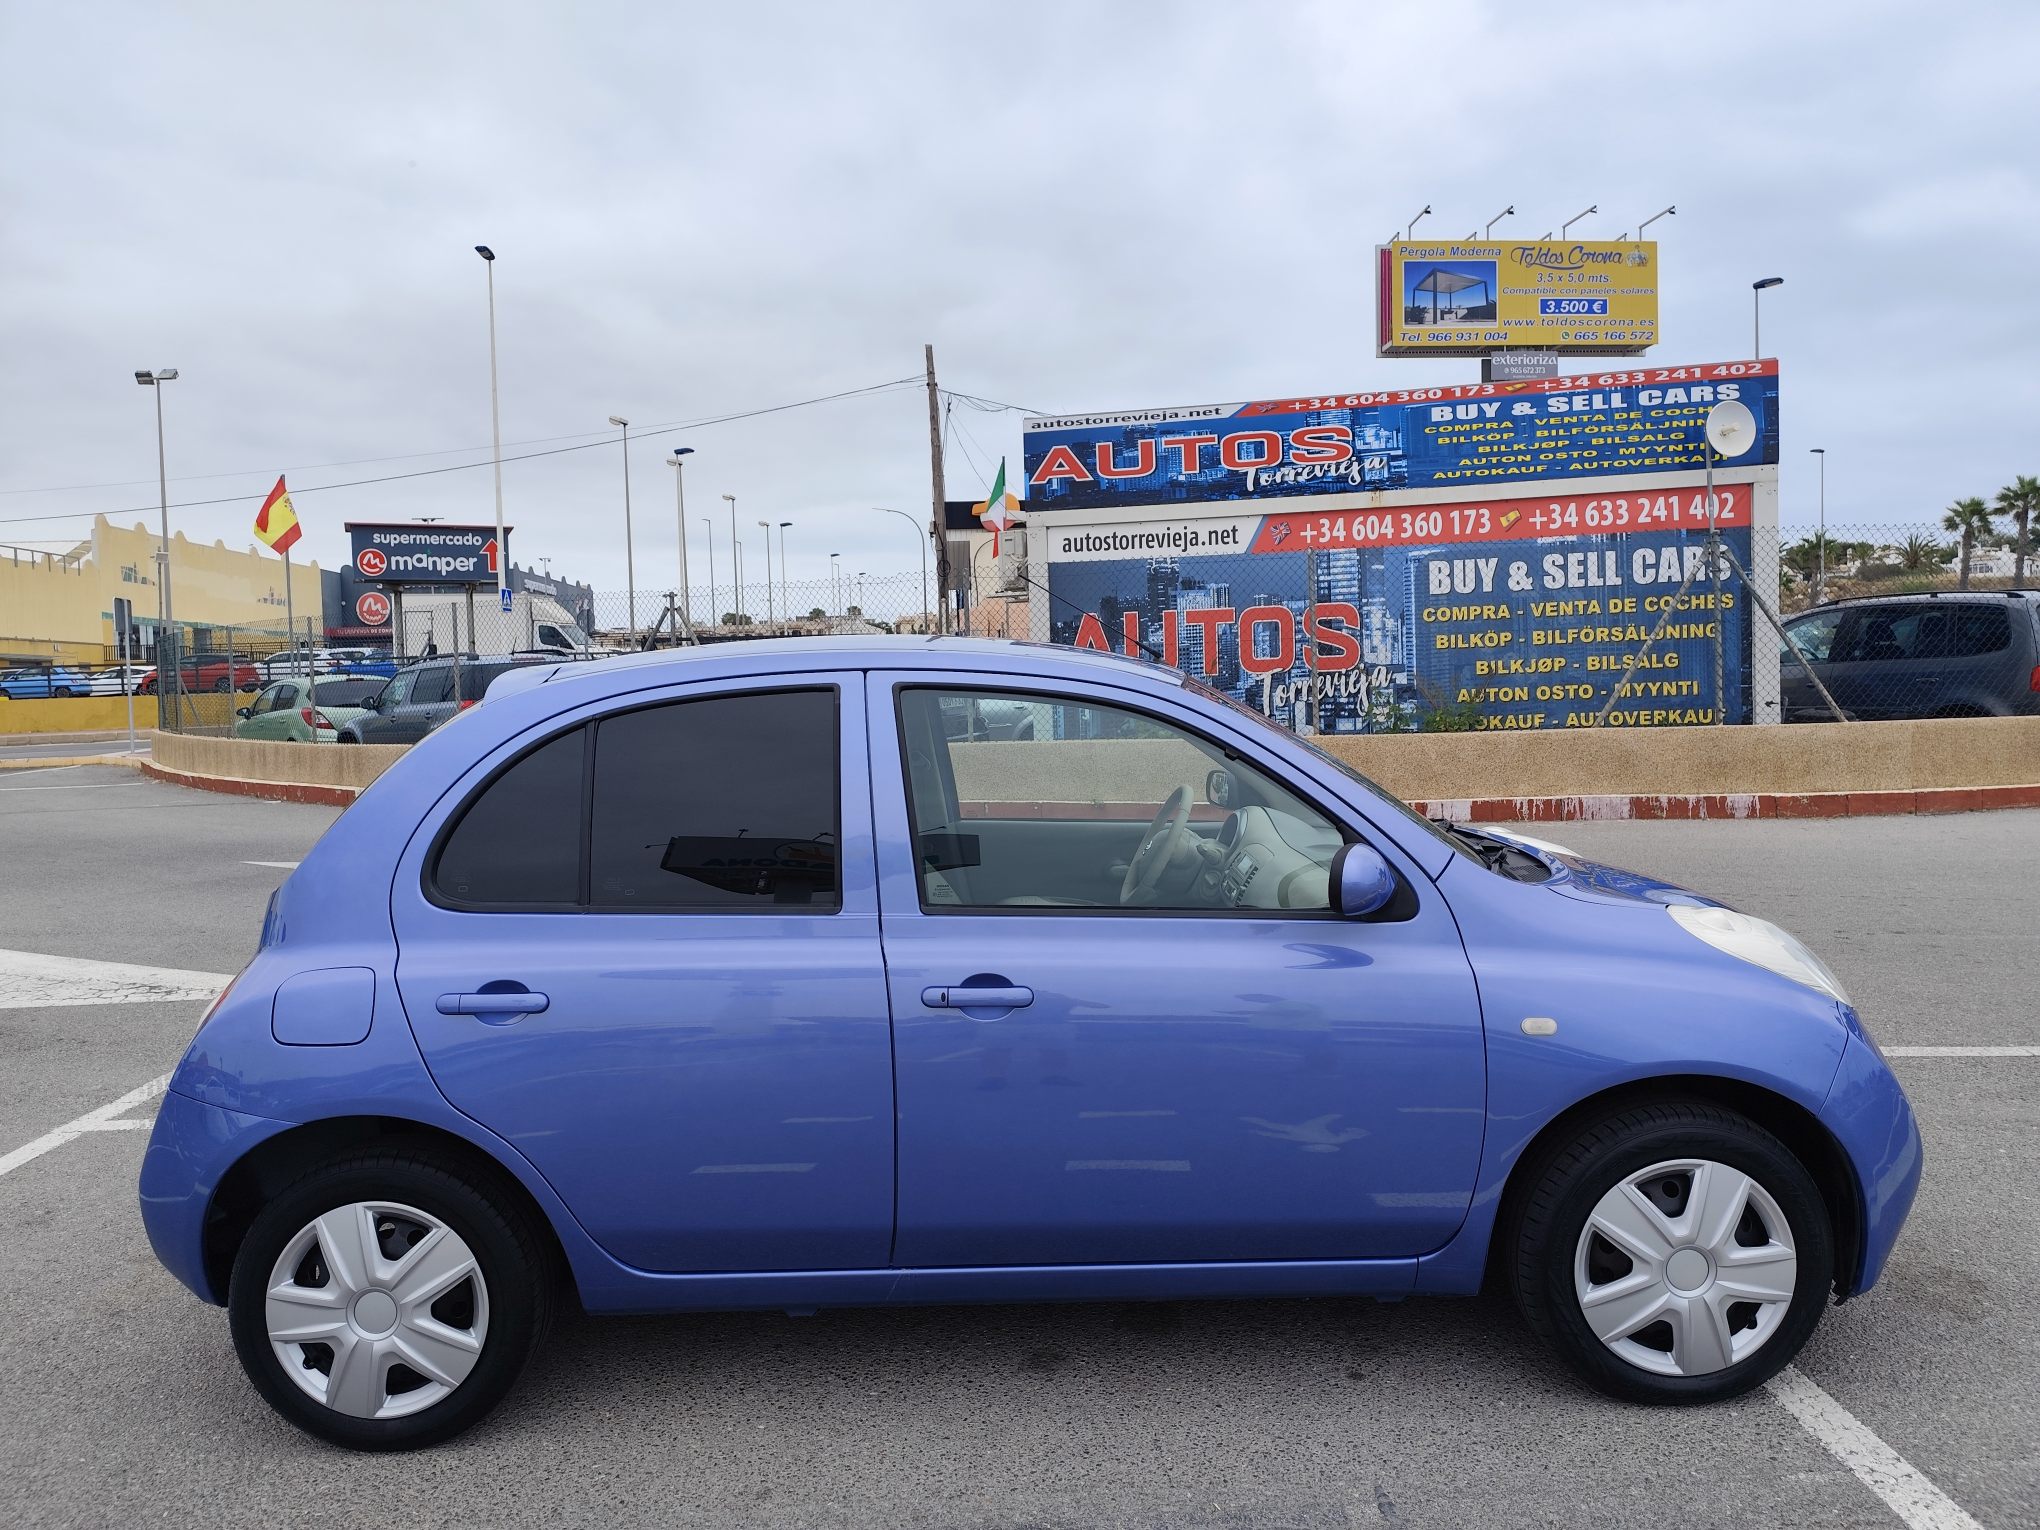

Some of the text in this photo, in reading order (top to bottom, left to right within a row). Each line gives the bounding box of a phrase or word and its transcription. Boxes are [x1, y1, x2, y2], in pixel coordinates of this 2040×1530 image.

[1450, 246, 1502, 257] Moderna
[1511, 245, 1624, 270] Toldos Corona
[1557, 275, 1563, 283] x
[1588, 273, 1612, 283] mts.
[1502, 286, 1557, 295] Compatible
[1580, 287, 1617, 296] paneles
[1620, 287, 1655, 295] solares
[1545, 300, 1603, 313] 3.500 €
[1503, 317, 1655, 327] www.toldoscorona.es
[1400, 331, 1508, 342] Tel. 966 931 004
[1574, 331, 1654, 341] 665 166 572
[1492, 353, 1557, 365] exterioriza
[1537, 363, 1763, 390] +34 633 241 402
[1288, 384, 1495, 411] +34 604 360 173
[1431, 383, 1740, 422] BUY & SELL CARS
[1031, 407, 1223, 430] autostorrevieja.net
[1424, 421, 1514, 434] COMPRA
[1534, 414, 1606, 426] VENTA
[1614, 411, 1643, 420] DE
[1650, 406, 1713, 417] COCH
[1437, 432, 1515, 445] BILKÖP
[1536, 418, 1707, 437] BILFÖRSÄLJNIN
[1478, 440, 1570, 453] BILKJØP
[1591, 432, 1686, 445] BILSALG
[1029, 425, 1353, 486] AUTOS
[1458, 454, 1532, 466] AUTON
[1539, 450, 1598, 461] OSTO
[1619, 442, 1706, 455] MYYNTI
[1236, 455, 1389, 491] Torrevieja
[1433, 465, 1548, 480] AUTOKAUF
[1528, 492, 1735, 530] +34 633 241 402
[1300, 508, 1491, 544] +34 604 360 173
[373, 532, 483, 547] supermercado
[1062, 524, 1239, 553] autostorrevieja.net
[391, 553, 478, 576] manper
[1429, 557, 1499, 595] BUY
[1507, 561, 1534, 592] &
[1543, 550, 1623, 590] SELL
[1422, 604, 1511, 622] COMPRA
[1530, 600, 1602, 618] VENTA
[1609, 597, 1637, 614] DE
[1435, 630, 1513, 649] BILKÖP
[1475, 657, 1567, 675] BILKJØP
[1587, 652, 1680, 671] BILSALG
[1536, 684, 1594, 701] OSTO
